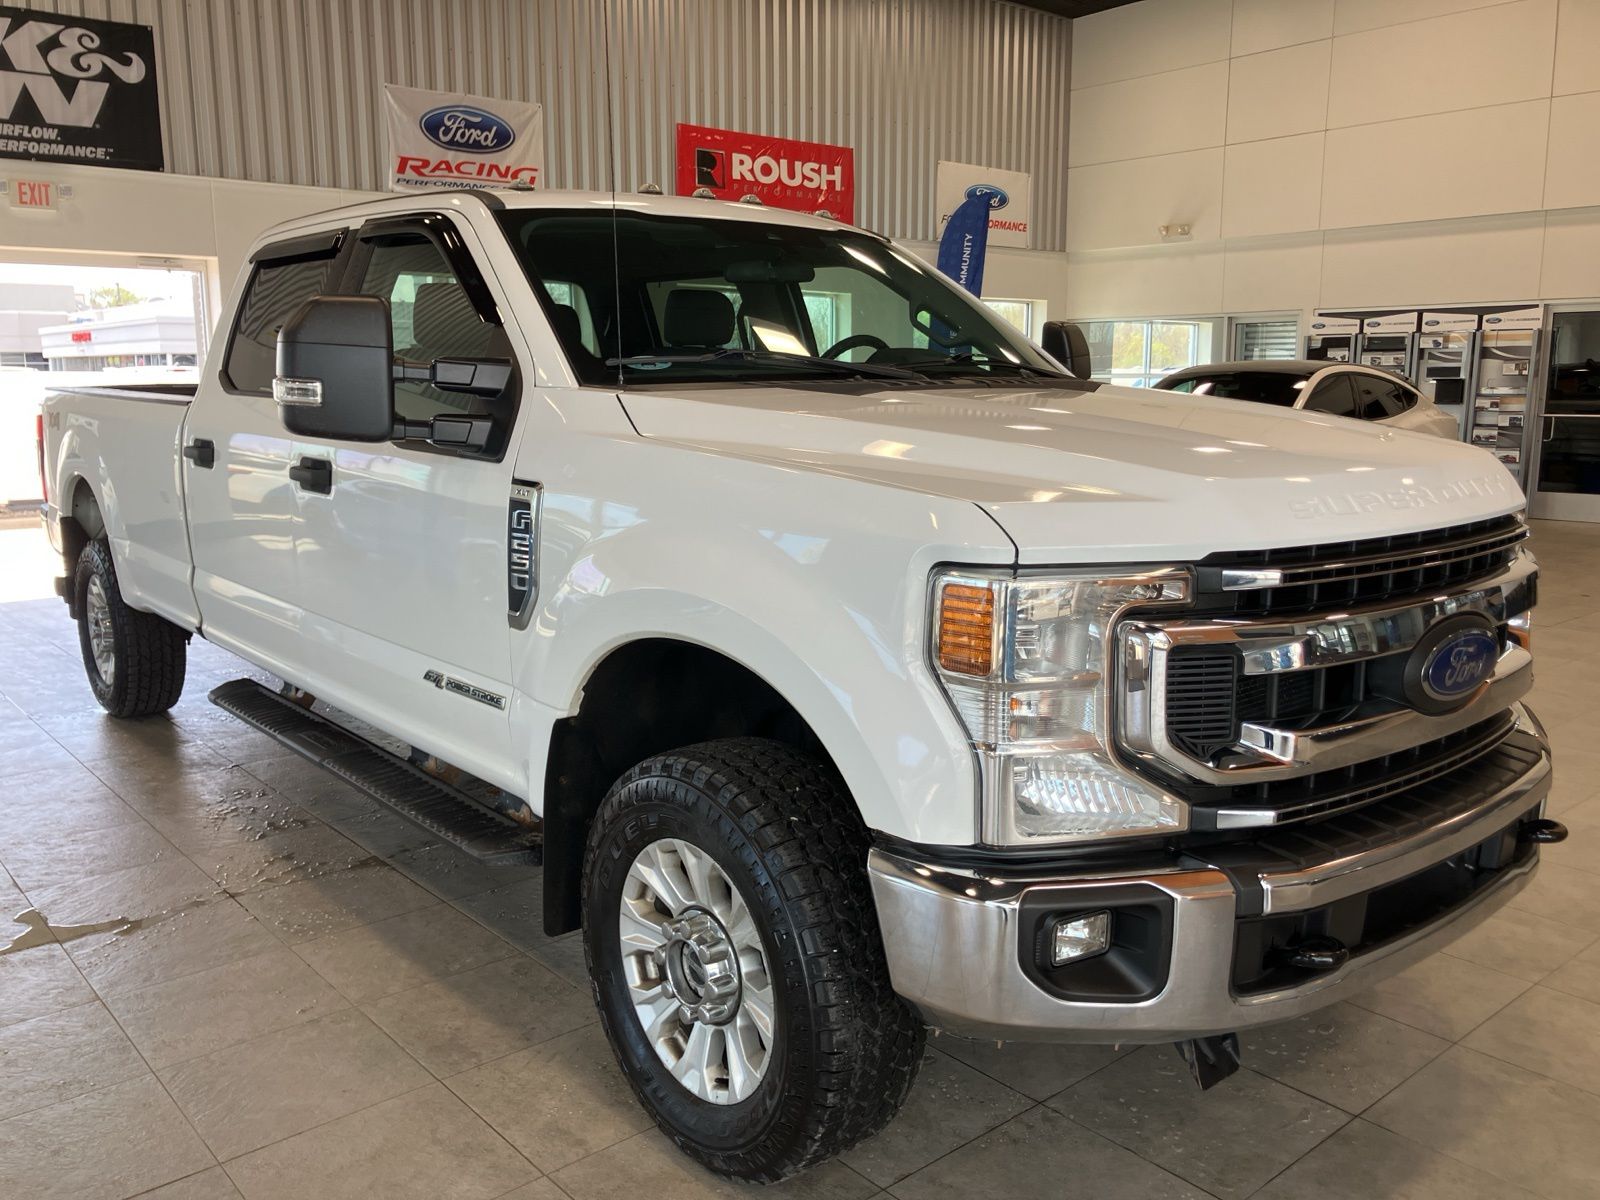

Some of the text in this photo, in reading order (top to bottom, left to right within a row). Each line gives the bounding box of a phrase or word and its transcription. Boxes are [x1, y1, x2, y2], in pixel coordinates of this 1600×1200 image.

[438, 111, 498, 148] Ford
[396, 155, 538, 185] RACING
[396, 177, 499, 191] PERFORMAN
[732, 153, 842, 192] ROUSH
[17, 181, 51, 206] EXIT
[988, 219, 1028, 233] ORMANCE
[959, 233, 974, 285] MMUNITY
[514, 487, 530, 497] XLT
[1445, 646, 1485, 687] Ford
[446, 679, 471, 694] POWER
[471, 688, 502, 706] STROKE
